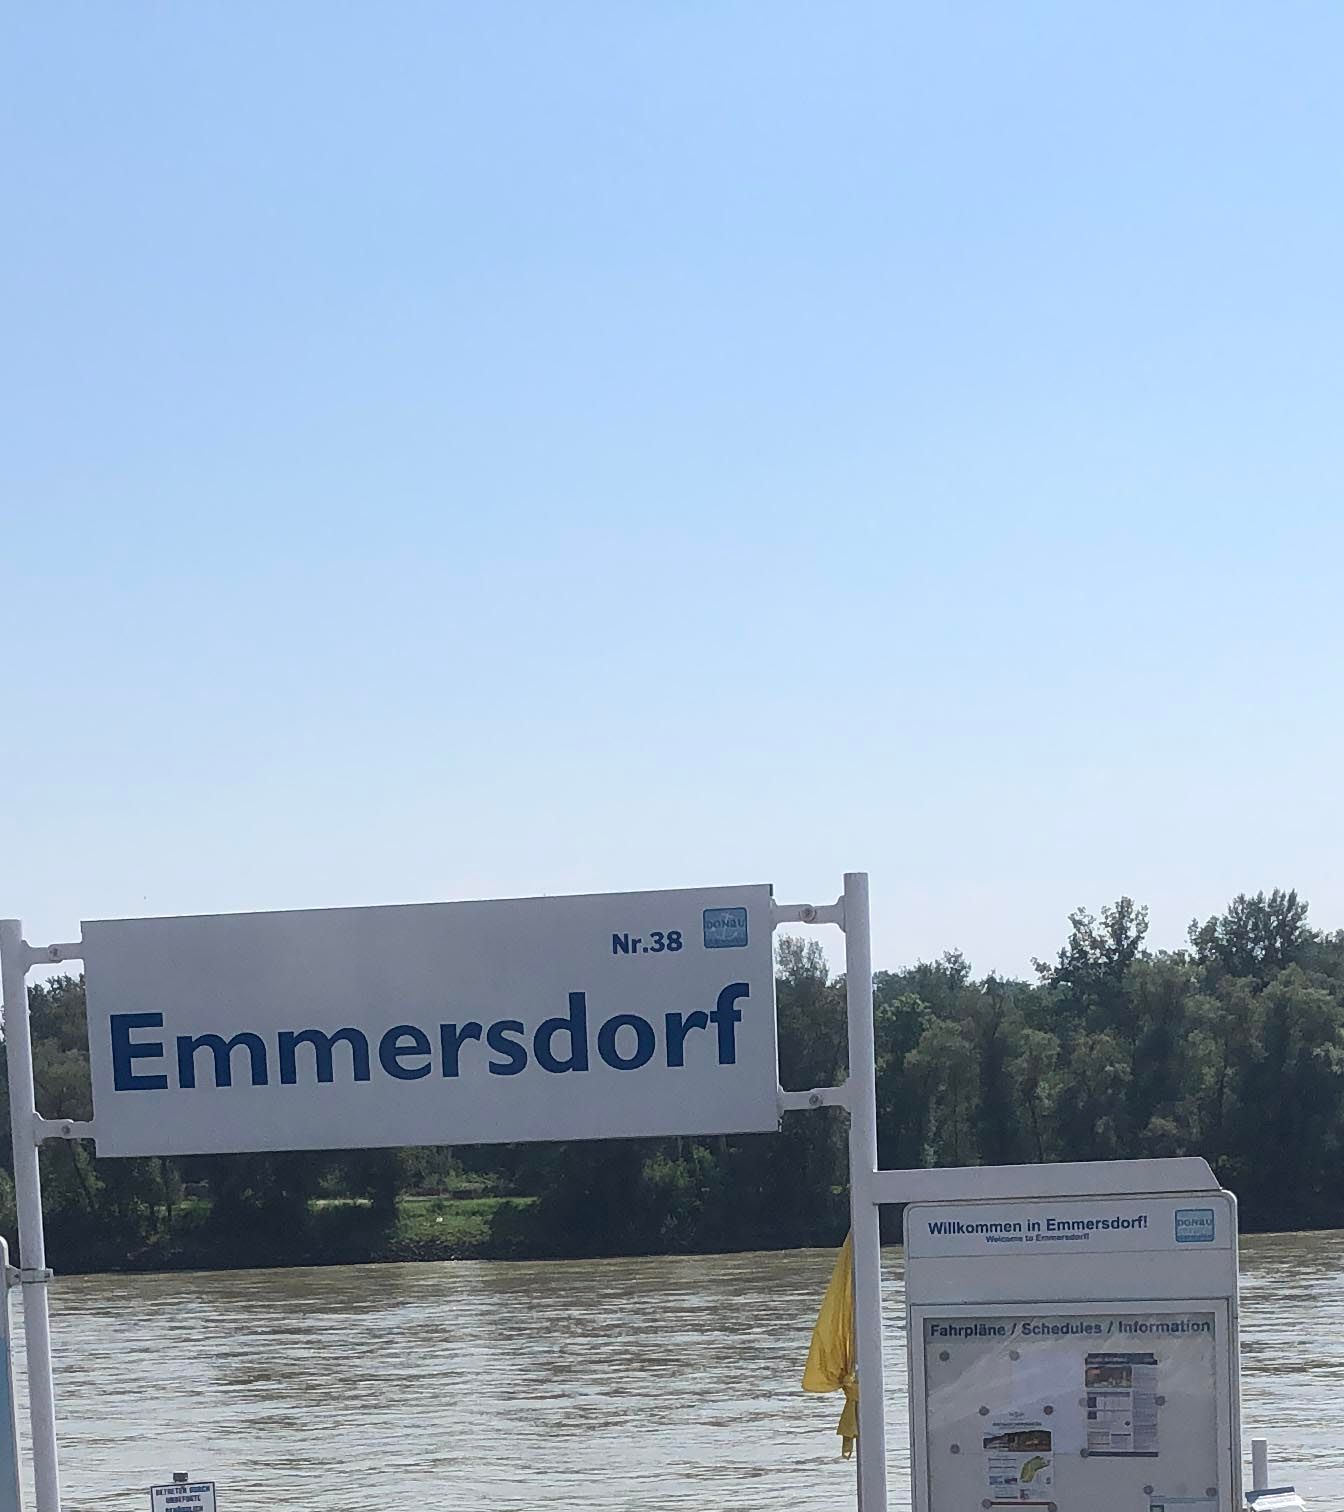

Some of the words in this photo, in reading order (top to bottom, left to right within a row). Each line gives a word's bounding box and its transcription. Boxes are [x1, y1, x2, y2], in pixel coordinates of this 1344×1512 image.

[612, 930, 683, 954] Nr.38
[109, 983, 750, 1091] Emmersdorf
[927, 1221, 1022, 1235] Willkommen
[1027, 1218, 1041, 1232] in
[1046, 1215, 1148, 1232] Emmersdorf!
[930, 1323, 1007, 1339] Fahrpläne
[1021, 1321, 1103, 1337] Schedules
[1118, 1320, 1211, 1334] Information
